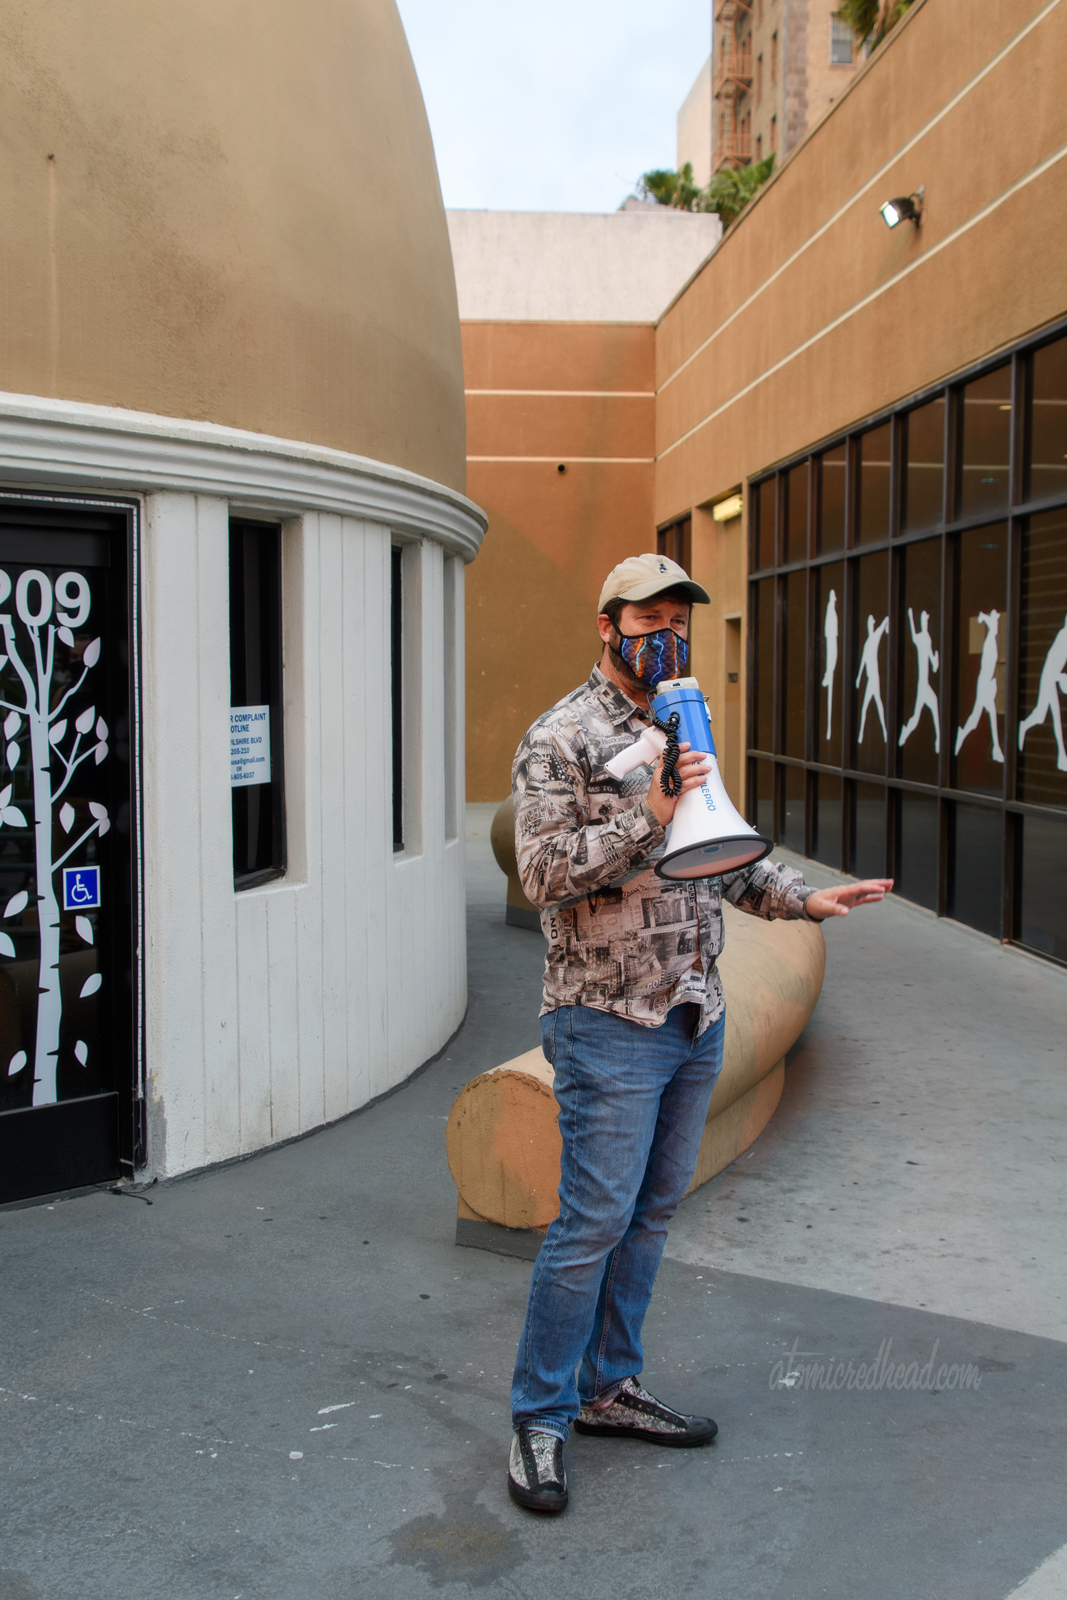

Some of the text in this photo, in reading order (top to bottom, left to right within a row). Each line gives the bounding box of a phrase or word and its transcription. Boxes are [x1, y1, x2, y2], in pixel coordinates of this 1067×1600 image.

[234, 712, 266, 722] COMPLAINT
[230, 724, 249, 733] OTLINE
[250, 736, 262, 744] BLVD
[698, 773, 716, 811] LEPRO
